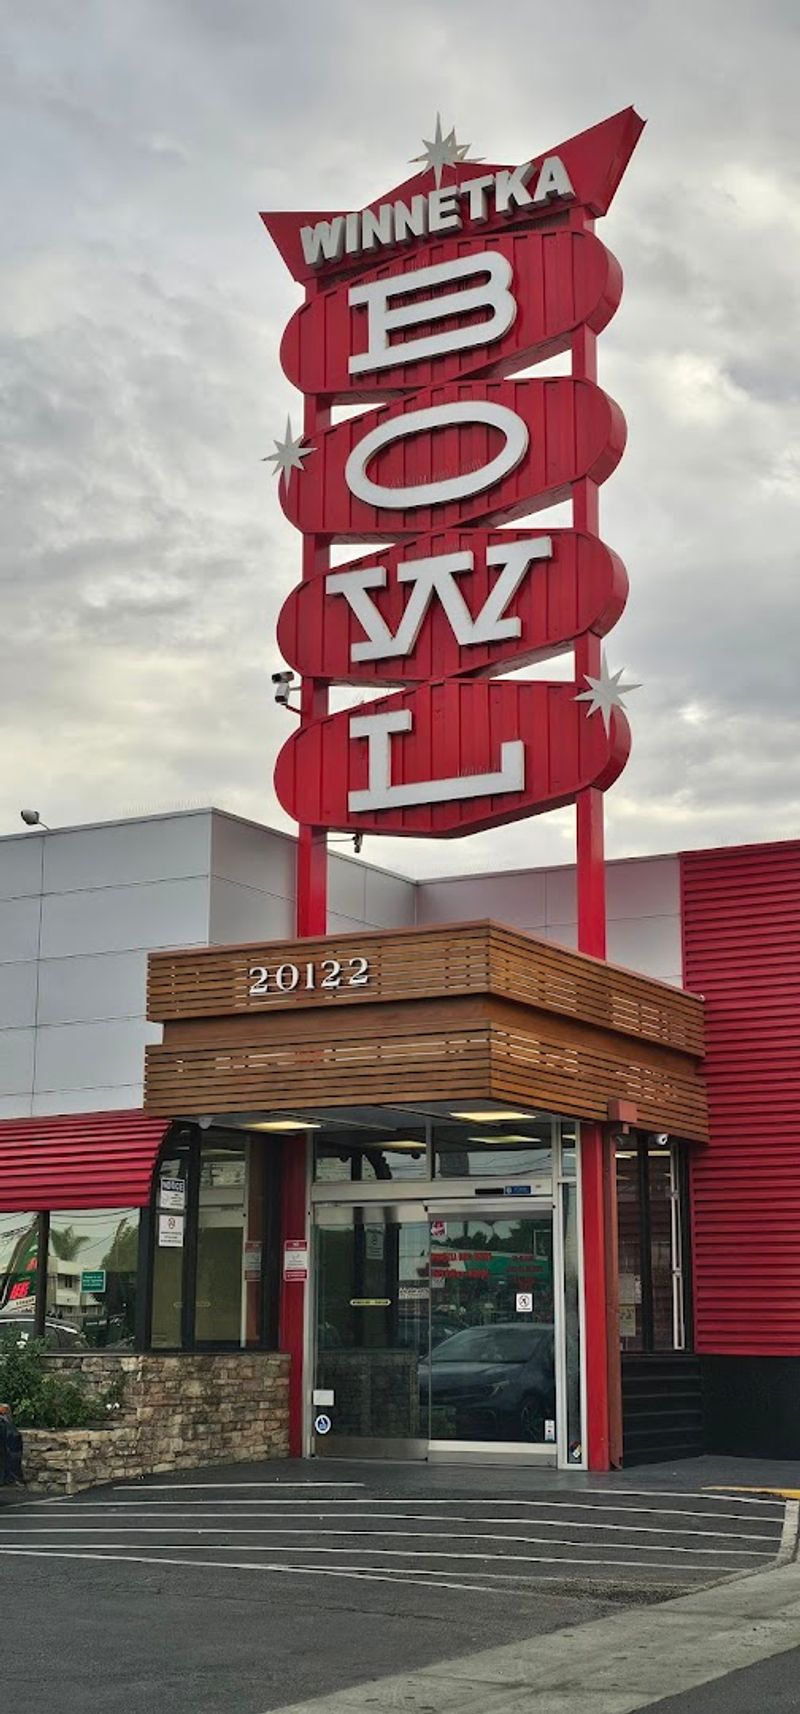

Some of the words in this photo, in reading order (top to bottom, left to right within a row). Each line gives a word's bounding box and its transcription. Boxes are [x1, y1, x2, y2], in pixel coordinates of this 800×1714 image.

[300, 155, 576, 265] WINNETKA
[326, 250, 552, 813] BOWL
[249, 957, 371, 995] 20122
